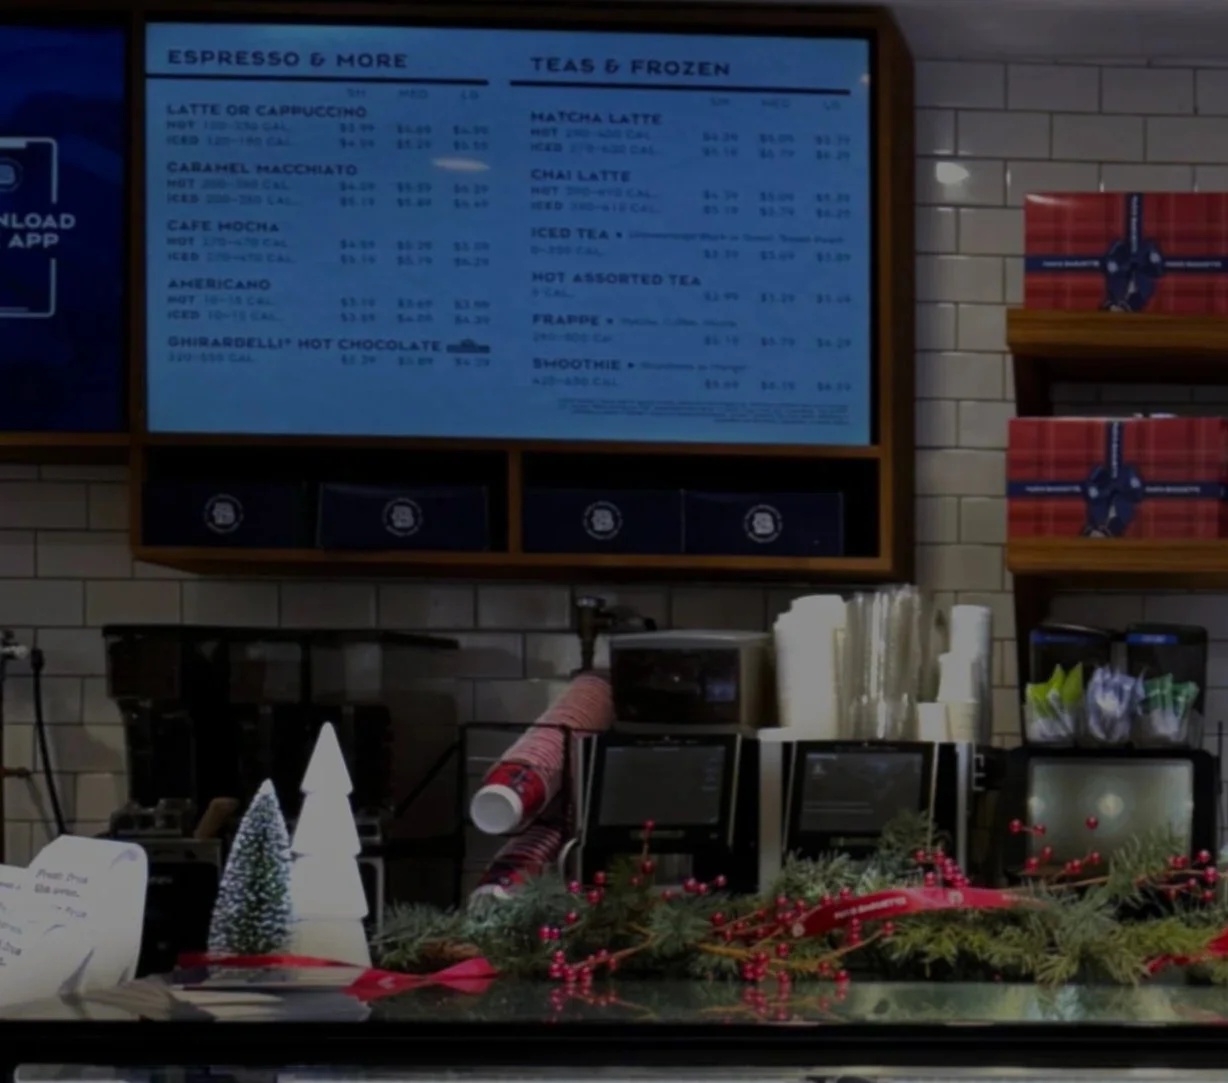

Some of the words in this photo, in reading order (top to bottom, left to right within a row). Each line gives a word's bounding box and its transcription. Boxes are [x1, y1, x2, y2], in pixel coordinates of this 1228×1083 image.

[167, 49, 300, 67] ESPRESSO
[310, 52, 326, 67] &
[336, 53, 408, 69] MORE
[530, 57, 596, 74] TEAS
[604, 58, 620, 75] &
[630, 59, 730, 76] FROZEN
[166, 103, 220, 116] LATTE
[226, 104, 250, 116] OR
[255, 105, 367, 118] CAPPUCCINO
[530, 111, 602, 123] MATCHA
[608, 113, 662, 125] LATTE
[166, 120, 195, 130] HOT
[530, 127, 558, 137] HOT
[166, 135, 199, 145] ICED
[530, 142, 563, 152] ICED
[166, 161, 250, 174] CARAMEL
[256, 163, 358, 176] MACCHIATO
[530, 168, 571, 181] CHAI
[577, 170, 631, 183] LATTE
[166, 178, 195, 189] HOT
[530, 186, 559, 195] HOT
[166, 193, 199, 204] ICED
[531, 201, 563, 211] ICED
[166, 219, 212, 232] CAFE
[218, 220, 280, 233] MOCHA
[531, 227, 571, 239] ICED
[576, 228, 609, 240] TEA
[8, 232, 60, 249] APP
[166, 236, 195, 246] HOT
[167, 252, 200, 262] ICED
[167, 278, 272, 291] AMERICANO
[531, 272, 565, 283] HOT
[572, 272, 663, 285] ASSORTED
[669, 274, 701, 286] TEA
[167, 295, 195, 305] HOT
[167, 310, 200, 320] ICED
[532, 313, 600, 326] FRAPPE
[298, 338, 331, 350] HOT
[338, 339, 441, 352] CHOCOLATE
[532, 358, 621, 371] SMOOTHIE
